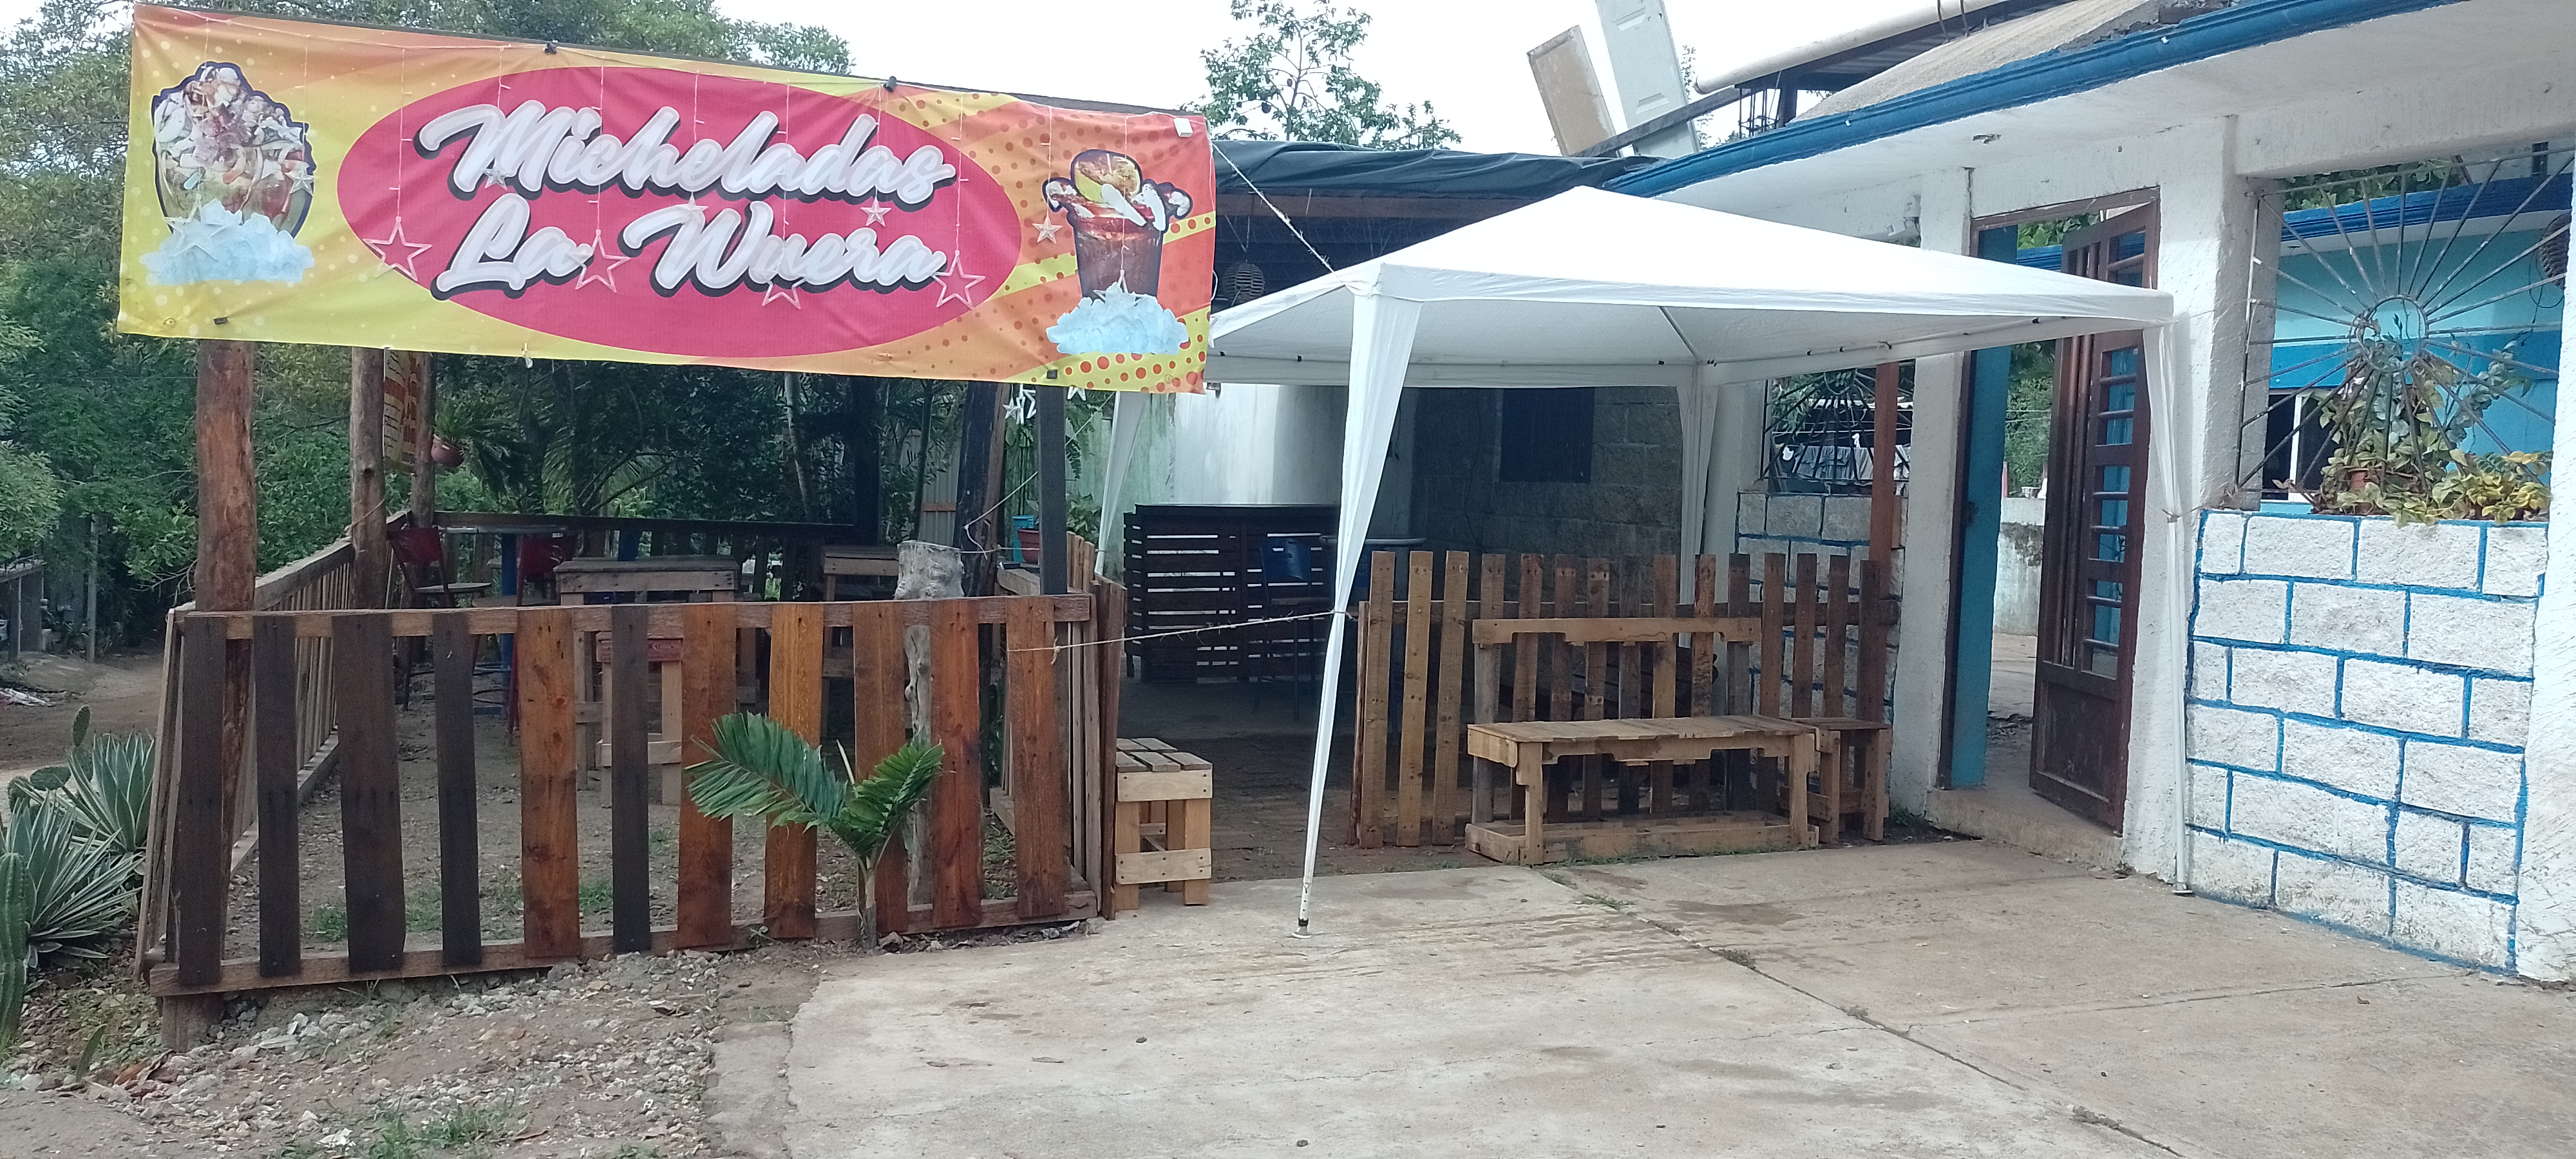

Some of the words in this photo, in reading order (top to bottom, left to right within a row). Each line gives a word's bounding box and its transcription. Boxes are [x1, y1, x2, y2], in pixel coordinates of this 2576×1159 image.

[415, 99, 957, 210] Micheladas
[432, 193, 594, 299] La
[619, 200, 947, 296] Wuera
